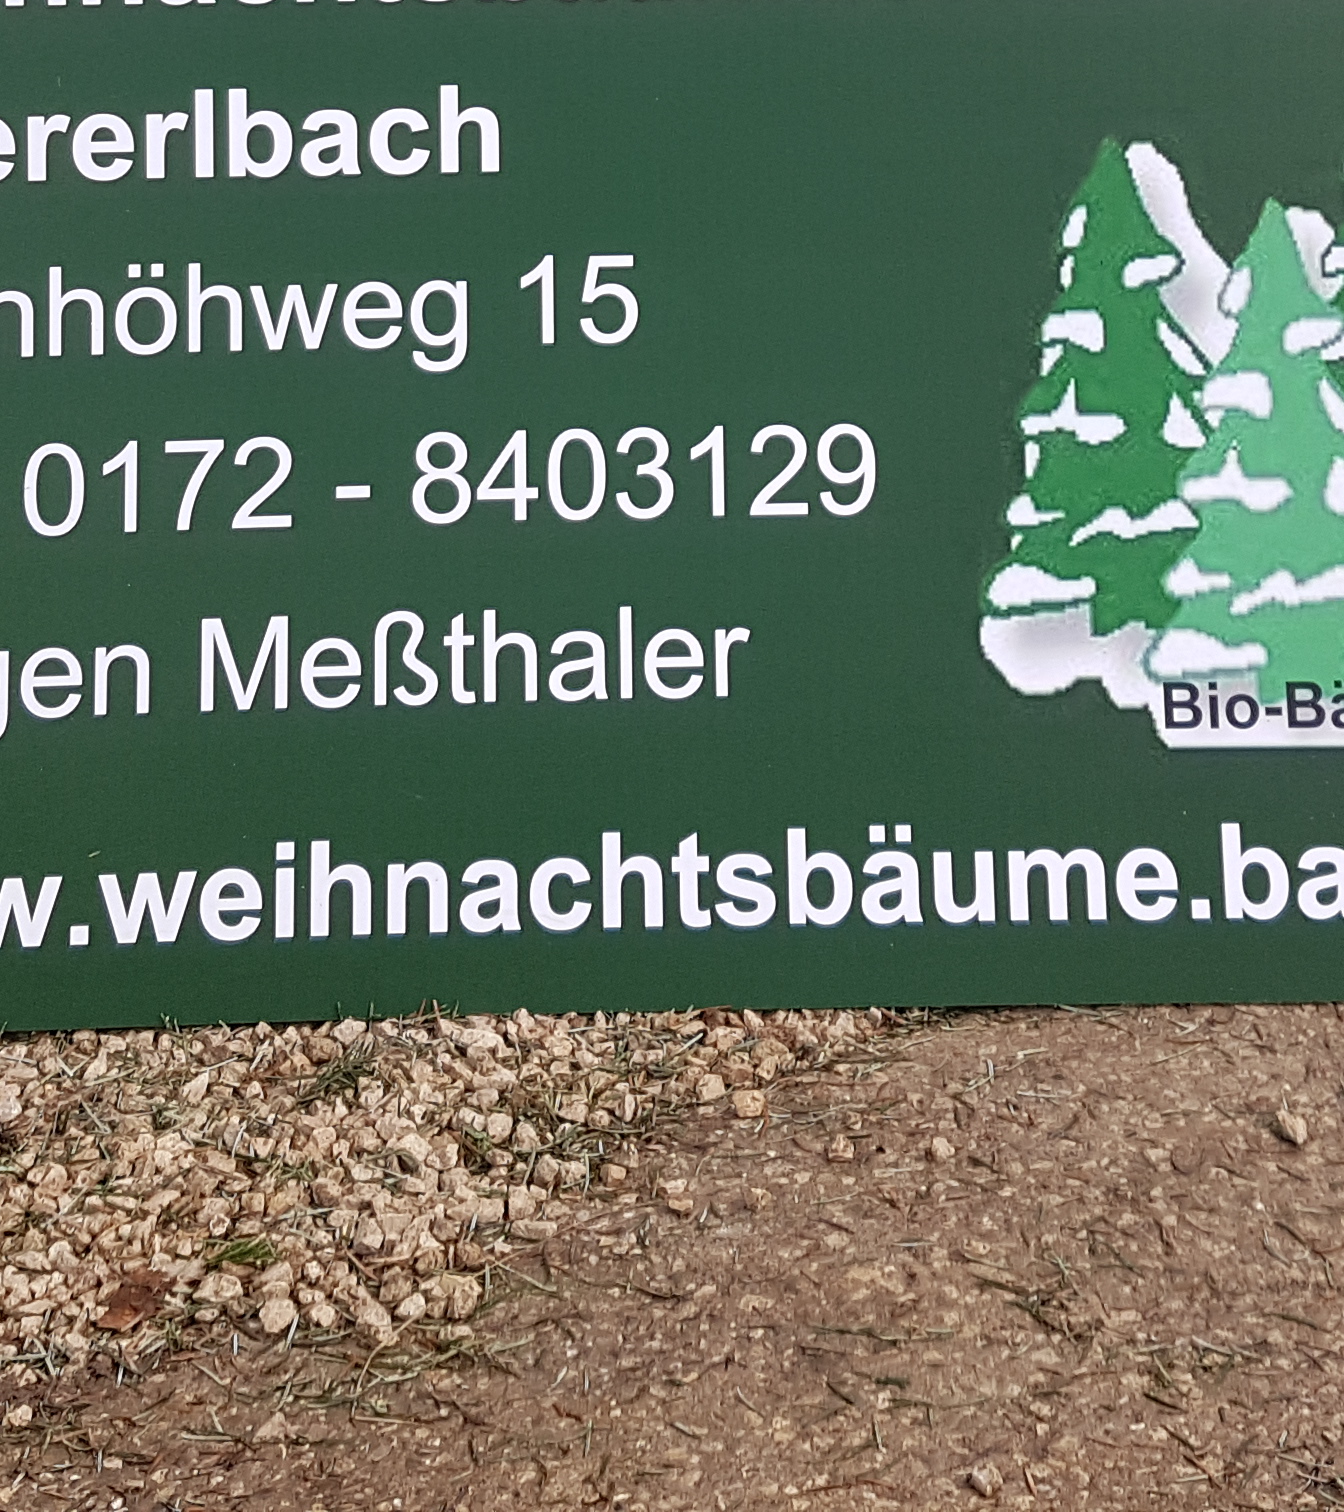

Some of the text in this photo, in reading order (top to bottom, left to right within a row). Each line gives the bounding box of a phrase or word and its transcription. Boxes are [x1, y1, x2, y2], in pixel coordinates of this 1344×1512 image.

[519, 253, 640, 346] 15
[22, 435, 294, 538] 0172
[334, 484, 372, 500] -
[410, 422, 877, 526] 8403129
[199, 604, 752, 713] Meßthaler
